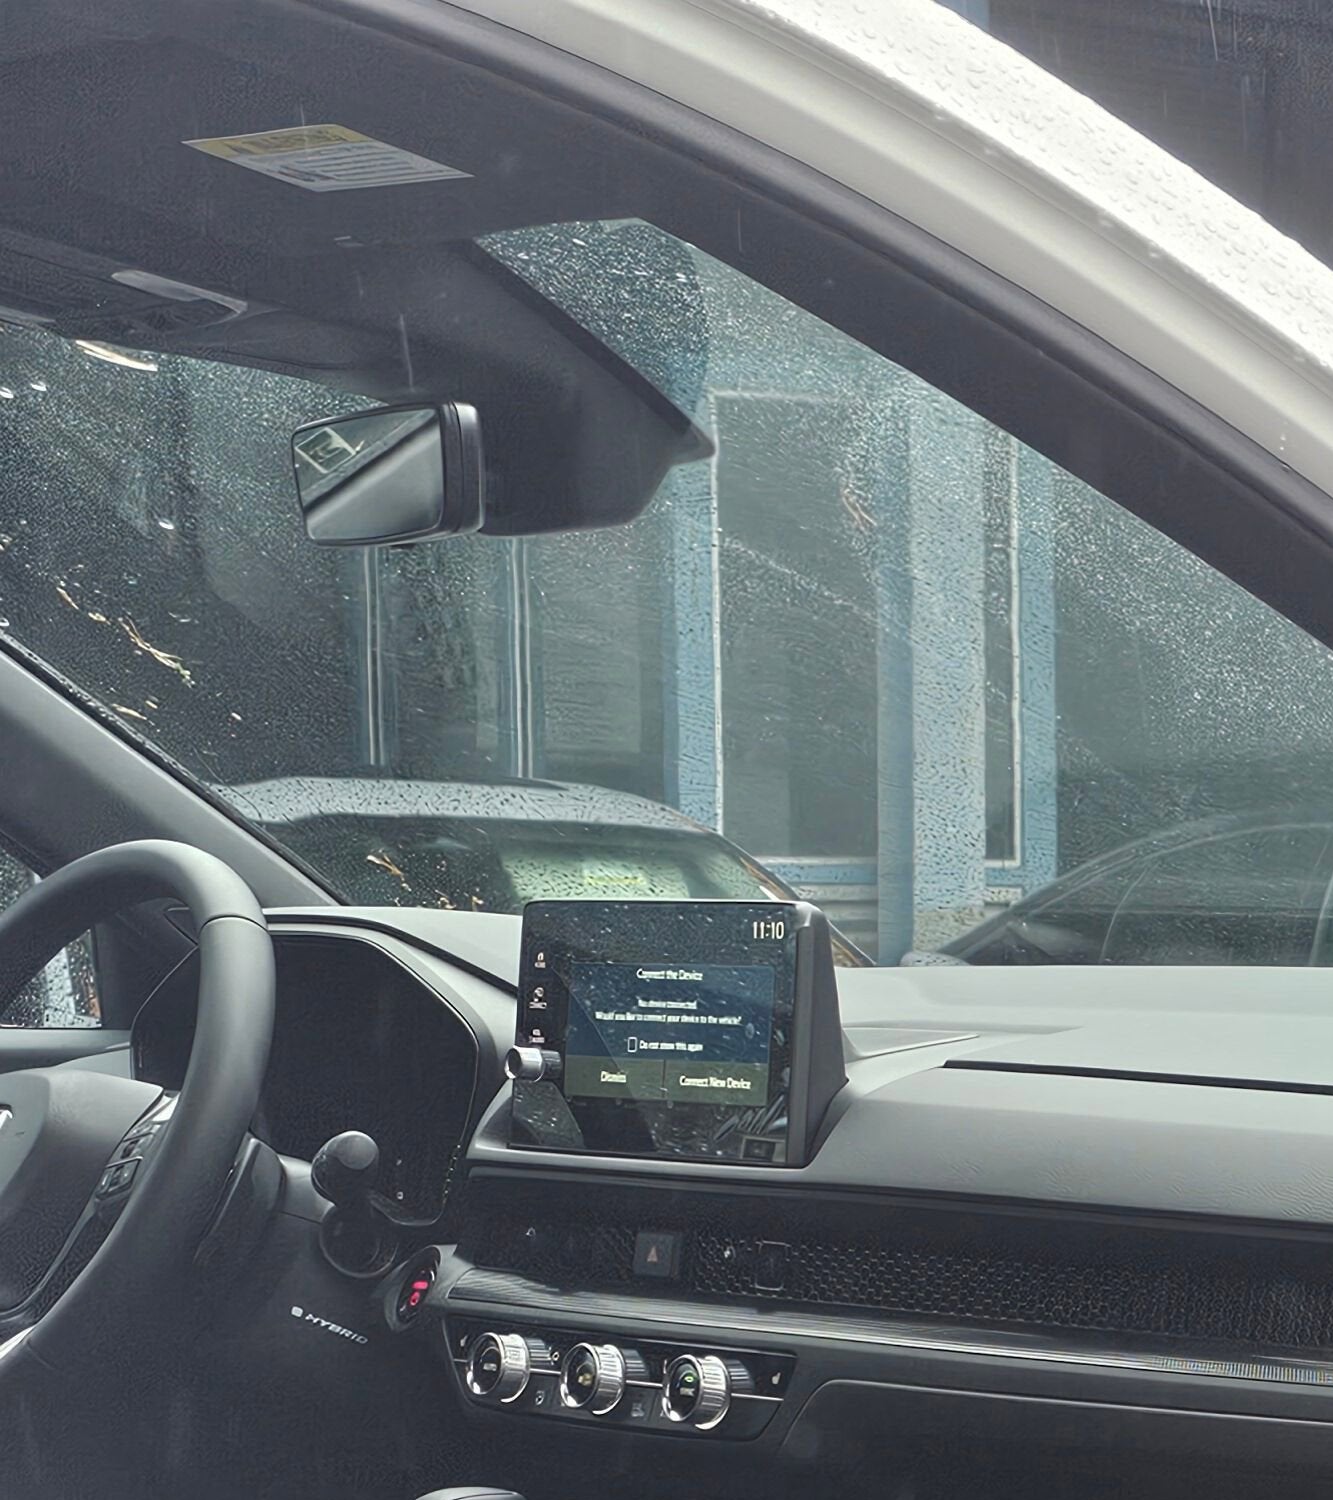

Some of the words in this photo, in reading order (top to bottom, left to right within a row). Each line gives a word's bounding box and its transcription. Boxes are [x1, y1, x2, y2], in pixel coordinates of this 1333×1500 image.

[753, 921, 785, 940] 11:10
[727, 1077, 751, 1090] Device
[305, 1313, 369, 1345] HYBRID
